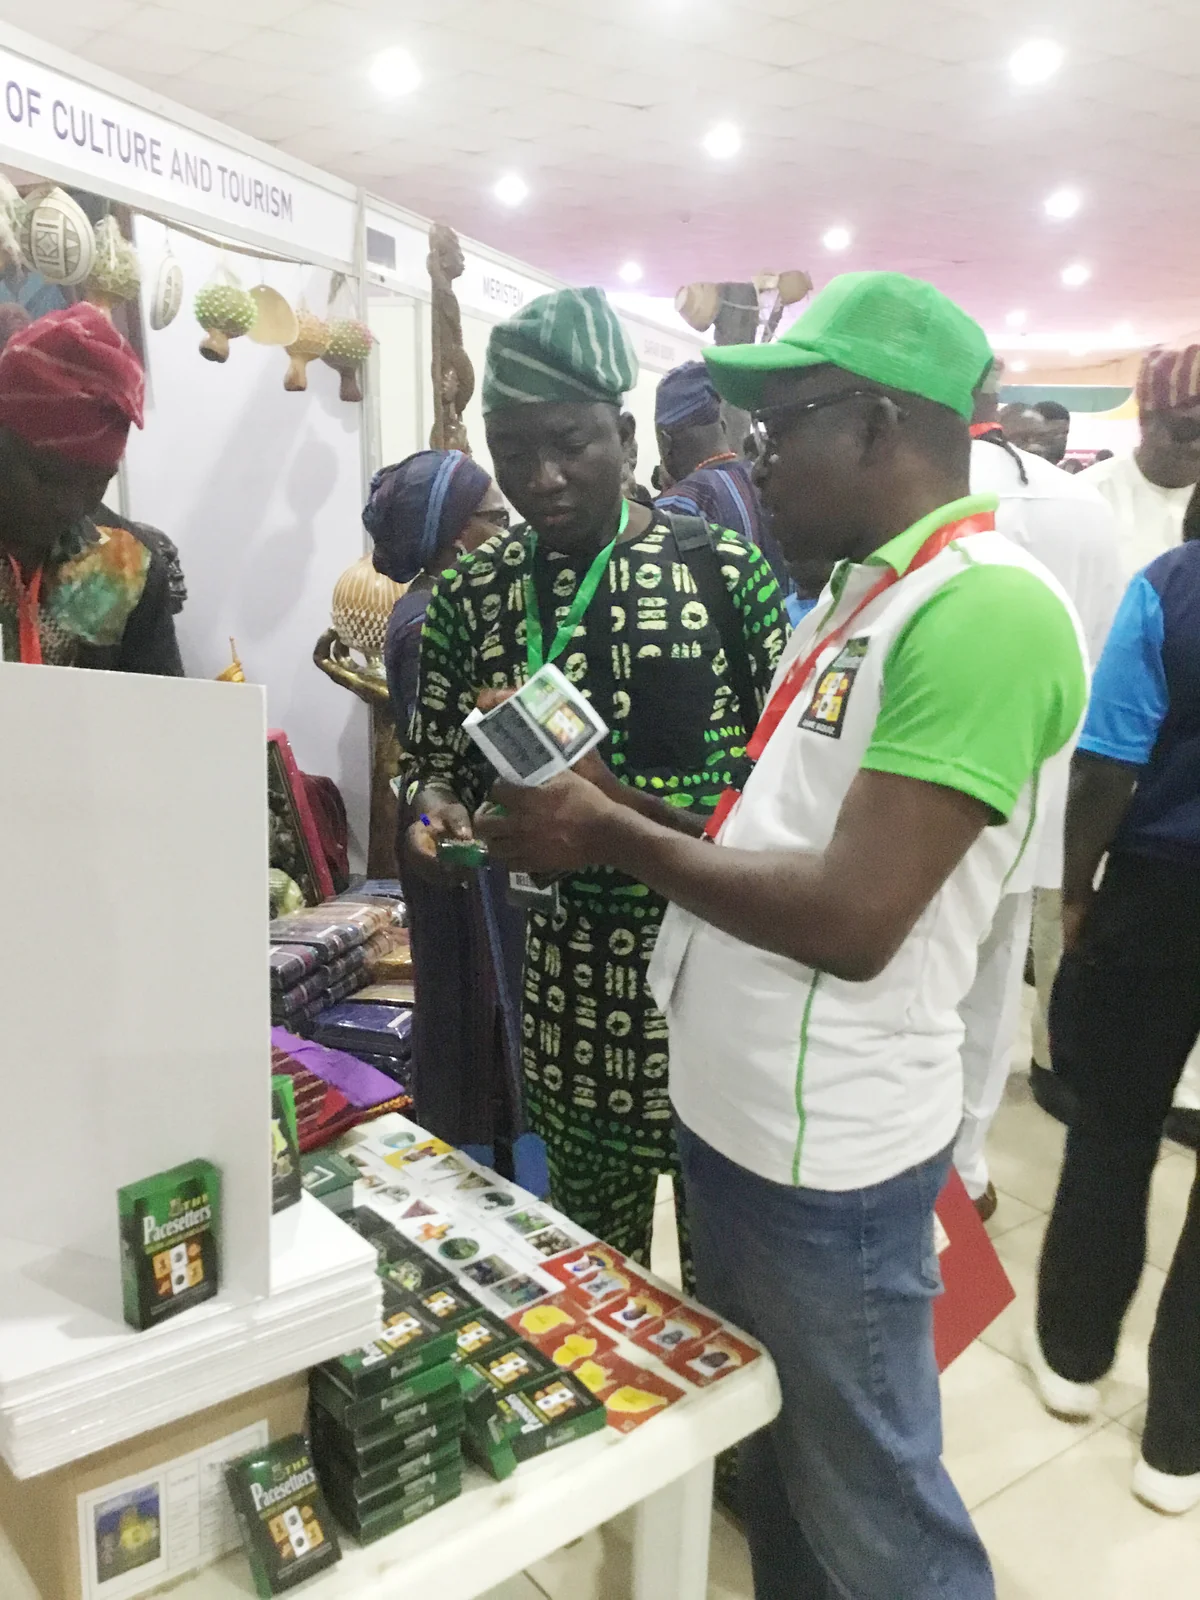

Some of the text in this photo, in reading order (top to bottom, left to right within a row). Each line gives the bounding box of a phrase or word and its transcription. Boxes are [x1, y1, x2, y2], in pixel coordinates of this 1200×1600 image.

[6, 80, 293, 222] OF CULTURE AND TOURISM
[483, 275, 524, 307] MERISTEM
[143, 1205, 211, 1245] Pacesetters
[250, 1467, 315, 1511] Pacesetters
